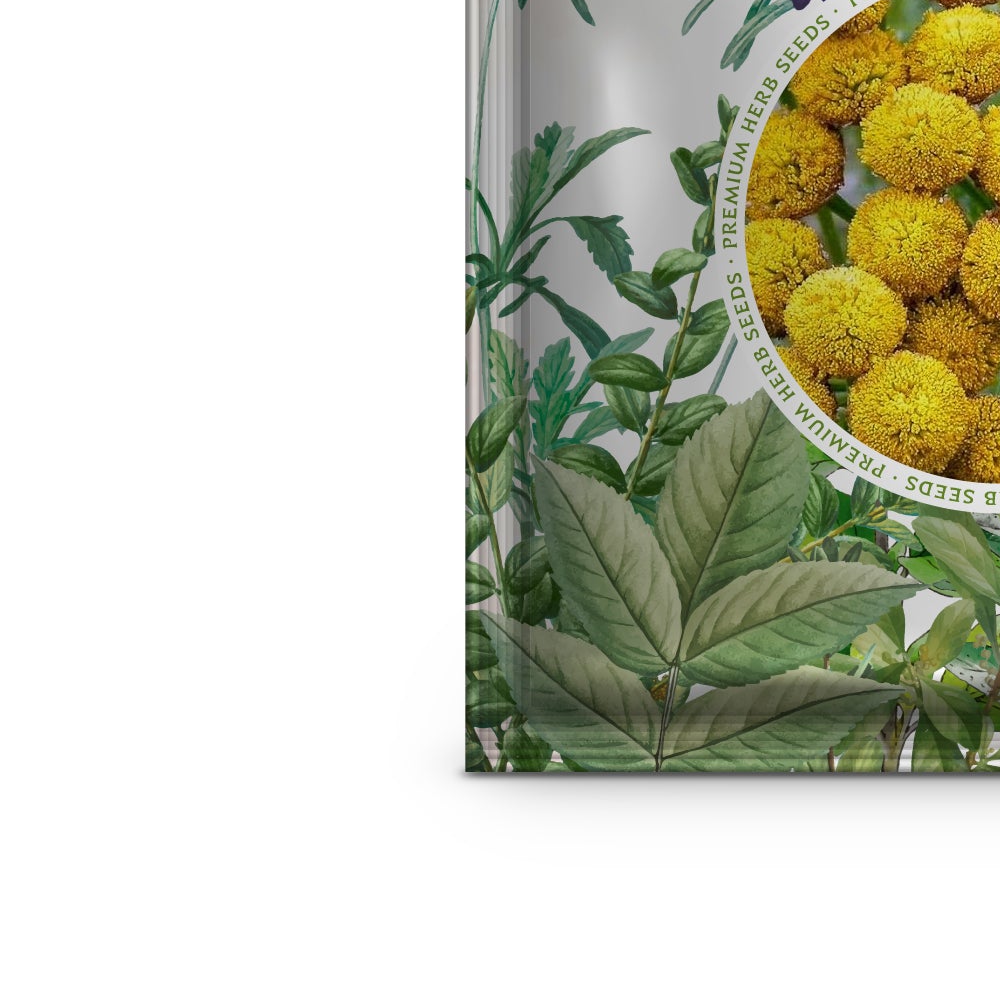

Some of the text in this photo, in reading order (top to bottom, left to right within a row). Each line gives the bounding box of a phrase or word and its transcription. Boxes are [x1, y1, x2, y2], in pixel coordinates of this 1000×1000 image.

[721, 15, 831, 249] PREMIUM HERB SEEDS
[726, 271, 887, 479] PREMIUM HERB SEEDS
[904, 474, 975, 505] SEEDS
